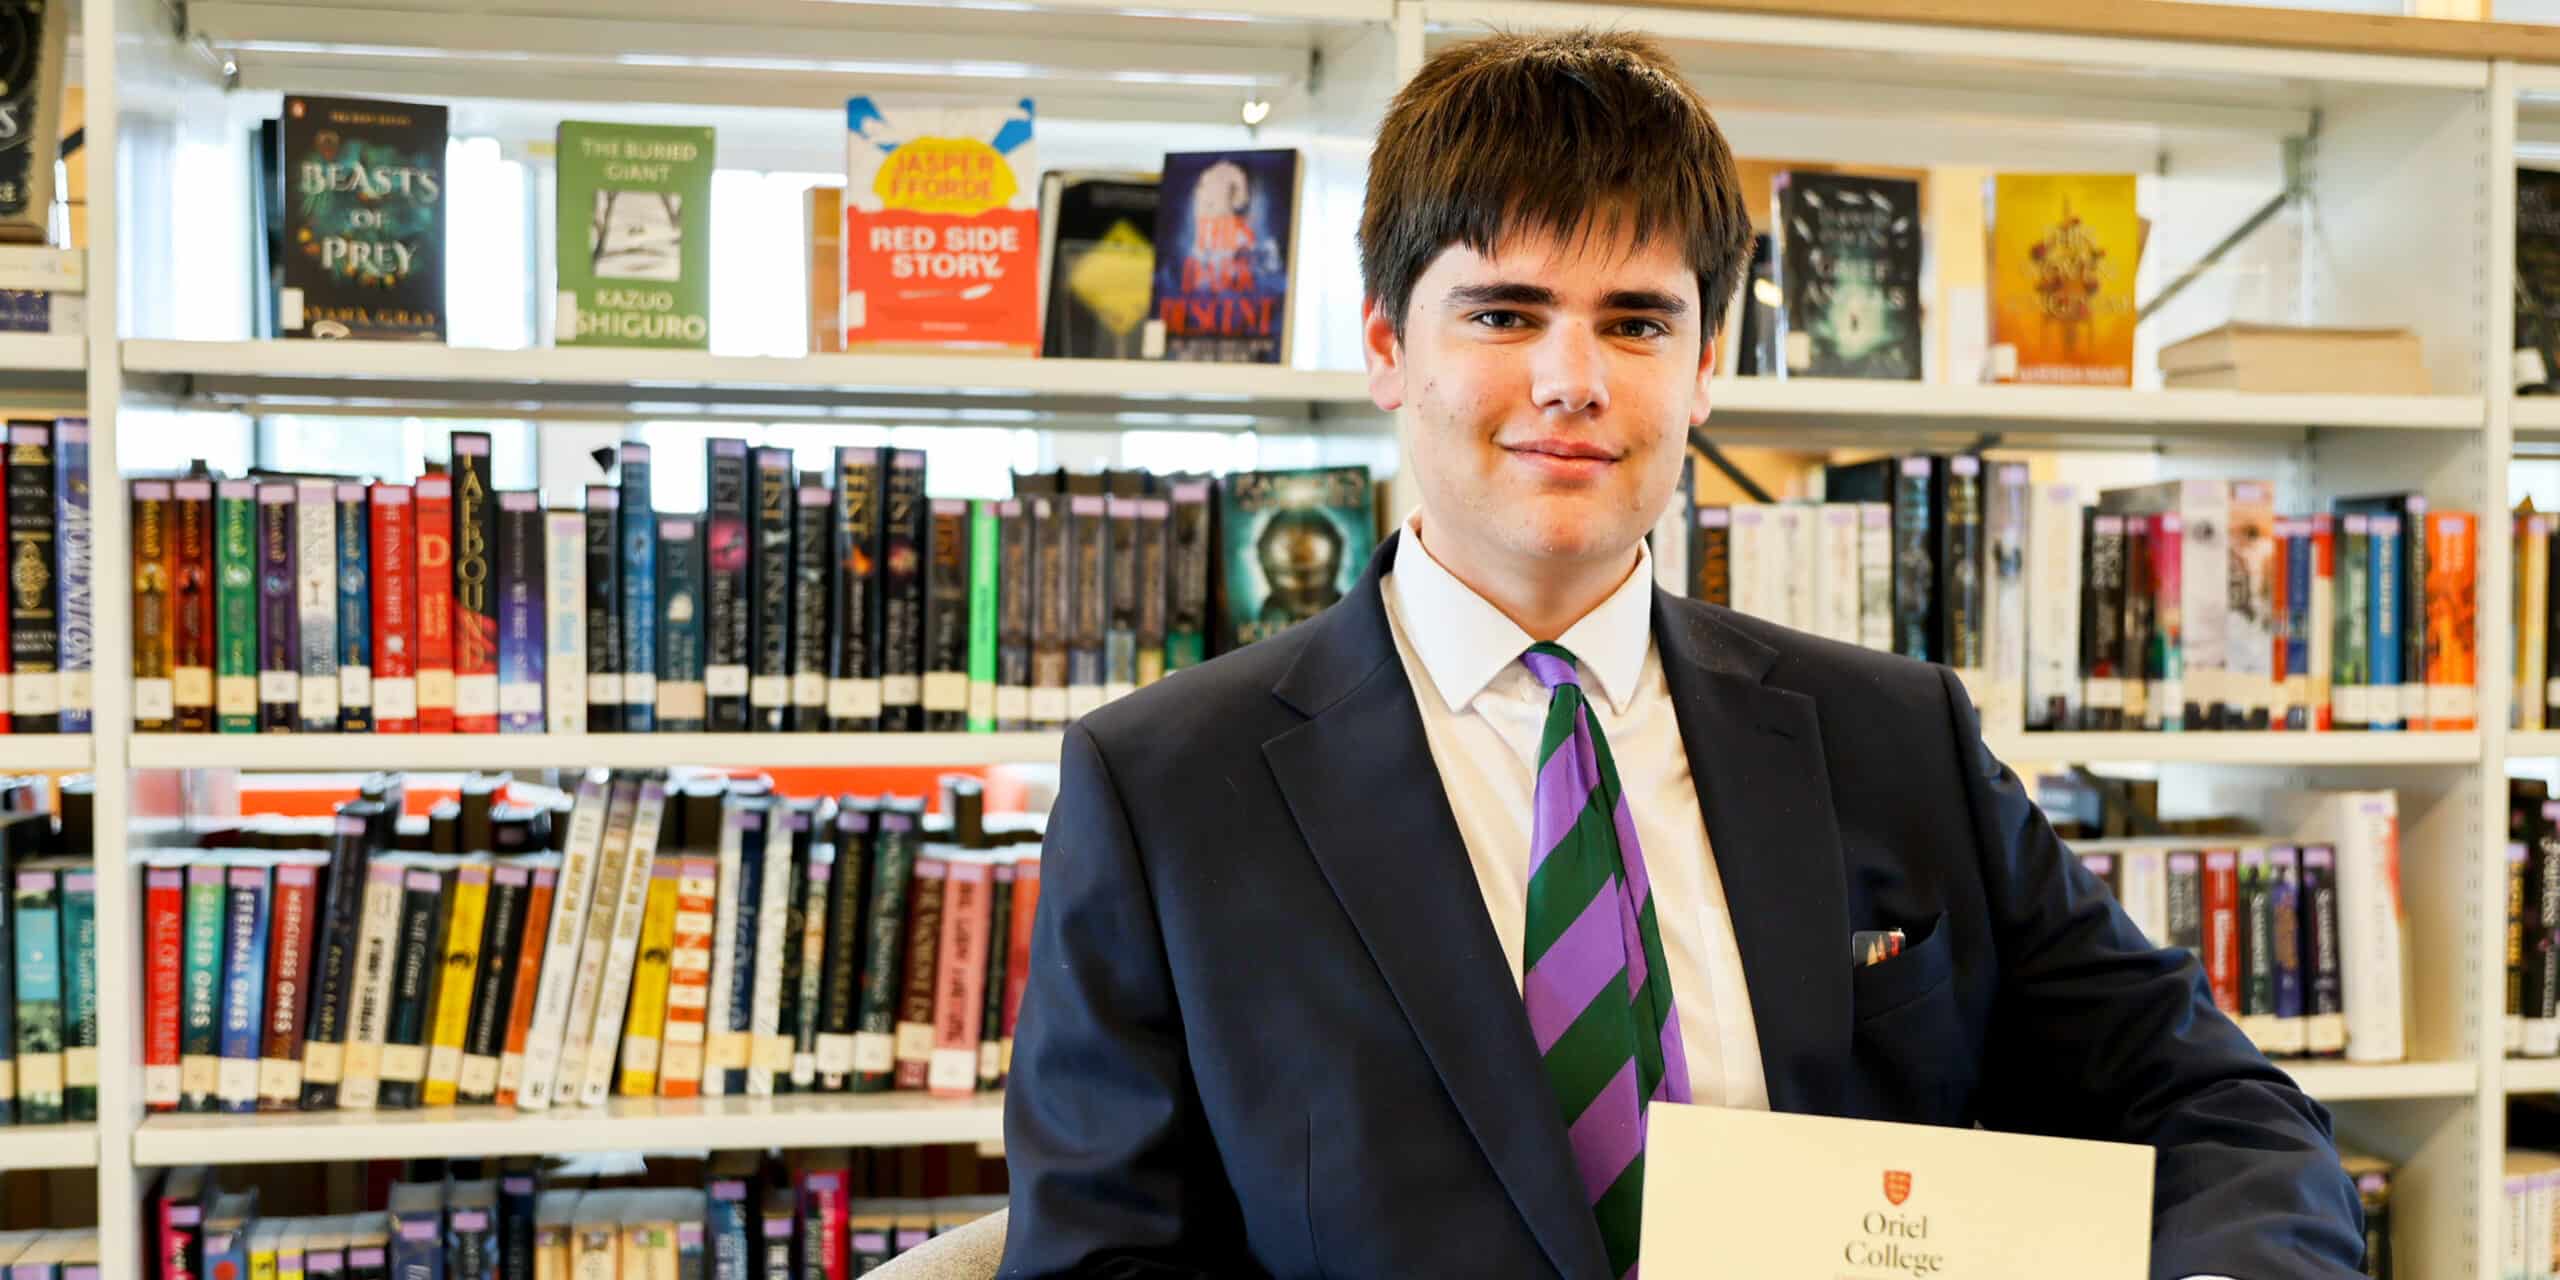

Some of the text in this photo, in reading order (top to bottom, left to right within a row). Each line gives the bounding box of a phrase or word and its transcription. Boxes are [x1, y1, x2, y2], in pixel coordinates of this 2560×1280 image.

[582, 138, 697, 162] THE BURIED
[895, 152, 995, 175] JASPER
[301, 161, 439, 204] BEASTS
[606, 163, 671, 182] GIANT
[890, 178, 993, 199] FFORDE
[351, 207, 386, 229] OF
[869, 226, 1020, 252] RED SIDE
[322, 235, 416, 276] PREY
[596, 288, 673, 311] KAZUO
[576, 310, 707, 341] SHIGURO
[1160, 296, 1276, 336] DESCENT
[421, 533, 452, 567] D
[160, 911, 177, 940] ALL
[160, 944, 177, 967] OF
[191, 891, 215, 1028] GILDED ONES
[229, 890, 256, 1030] ETERNAL ONES
[275, 888, 302, 1032] MERCILESS ONES
[1863, 1210, 1928, 1239] Oriel
[1844, 1240, 1944, 1278] College
